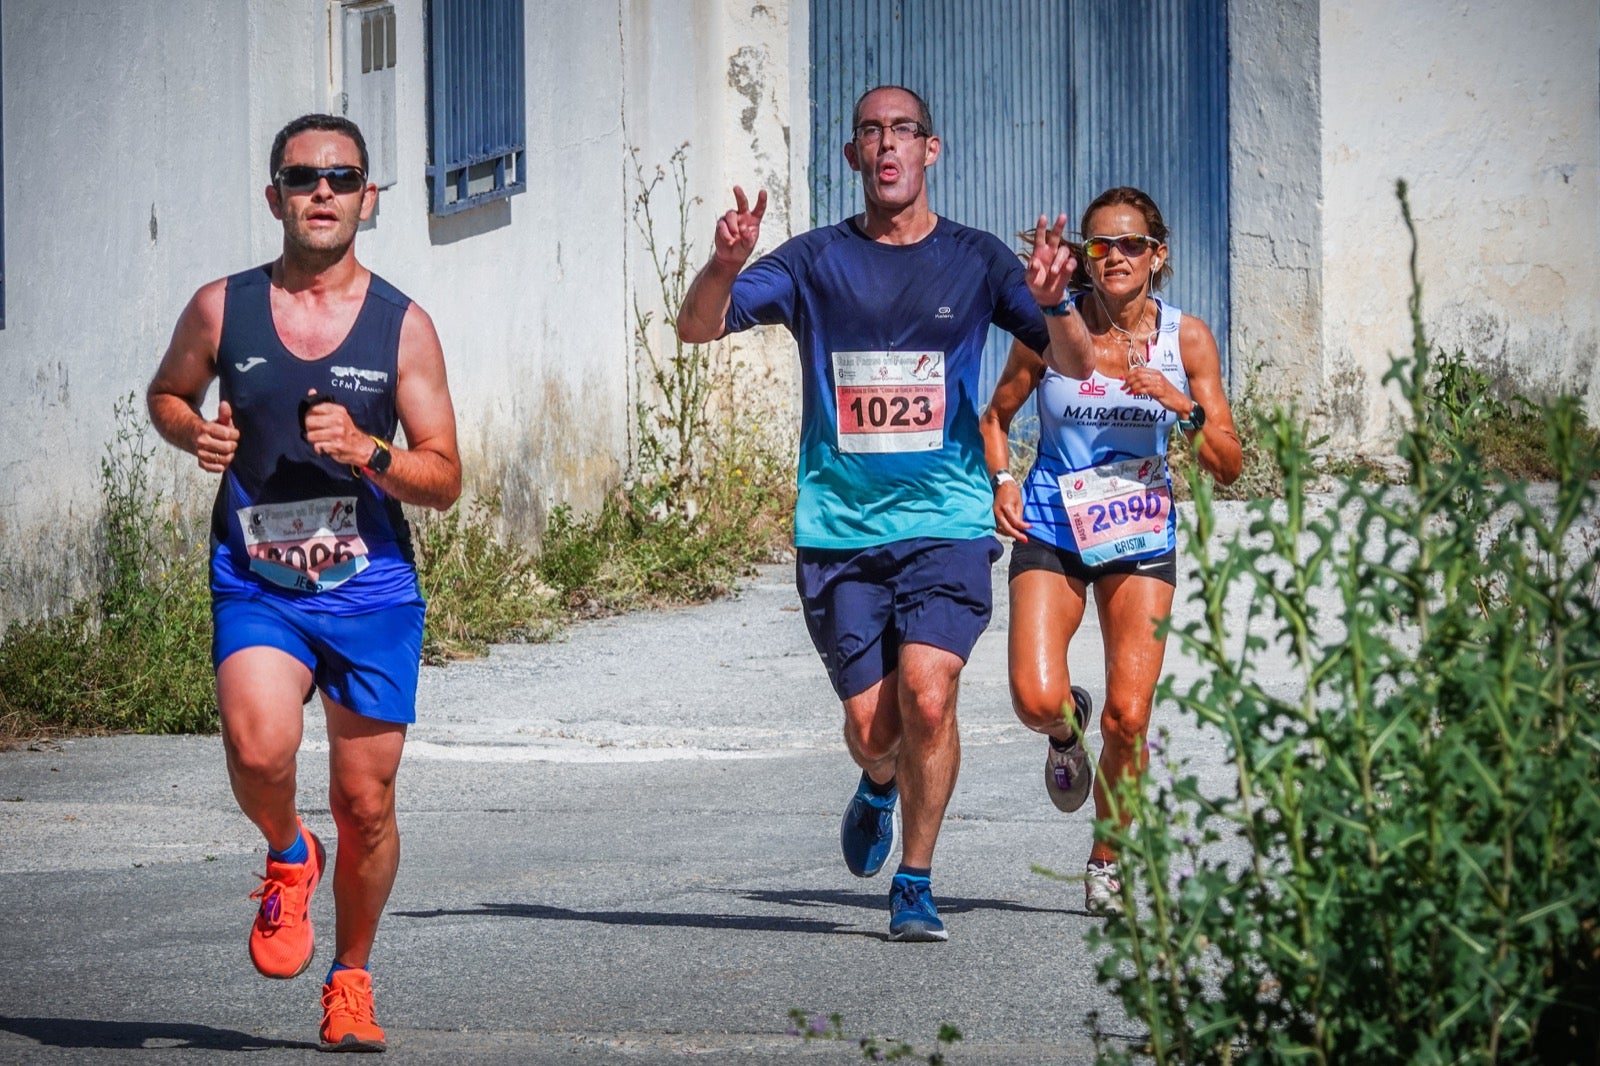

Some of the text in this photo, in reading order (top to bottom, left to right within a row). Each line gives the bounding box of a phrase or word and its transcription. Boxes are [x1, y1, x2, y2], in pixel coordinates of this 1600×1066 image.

[331, 379, 353, 390] CFM
[1078, 378, 1106, 396] als
[850, 396, 933, 427] 1023
[1063, 405, 1168, 422] MARACENA
[1087, 492, 1161, 533] 2090
